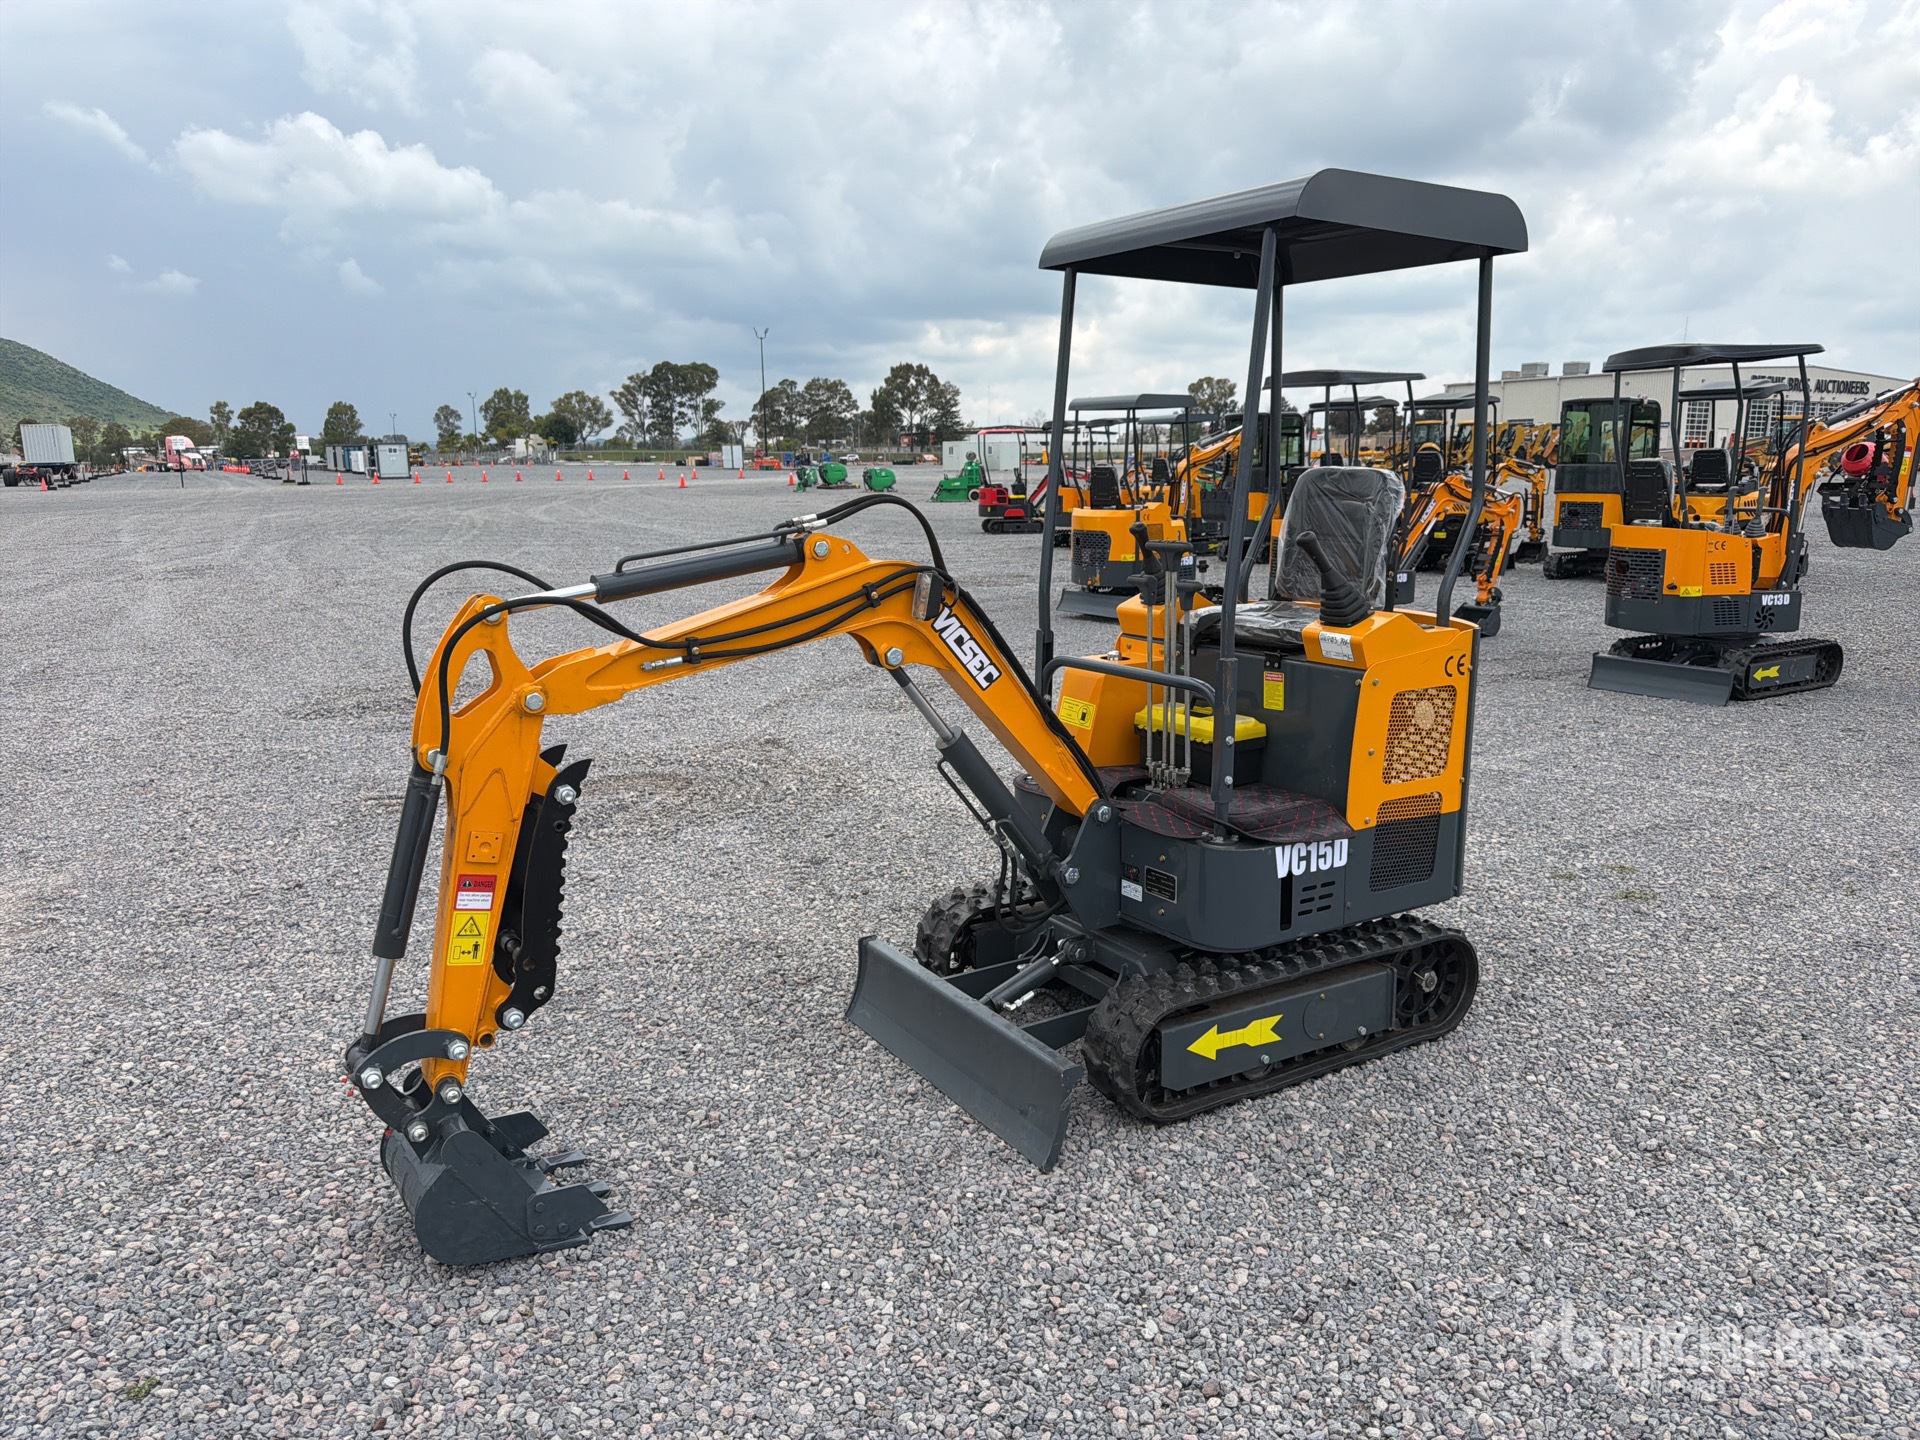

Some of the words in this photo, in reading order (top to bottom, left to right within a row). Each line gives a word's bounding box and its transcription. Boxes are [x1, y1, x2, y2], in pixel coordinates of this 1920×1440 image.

[1788, 377, 1812, 392] BR.
[1813, 379, 1870, 394] AUCTIONEERS
[1714, 540, 1727, 551] CE
[1762, 593, 1790, 606] VC13D
[933, 606, 1001, 689] VICSEC
[1444, 653, 1467, 678] CE
[1275, 838, 1349, 879] VC15D
